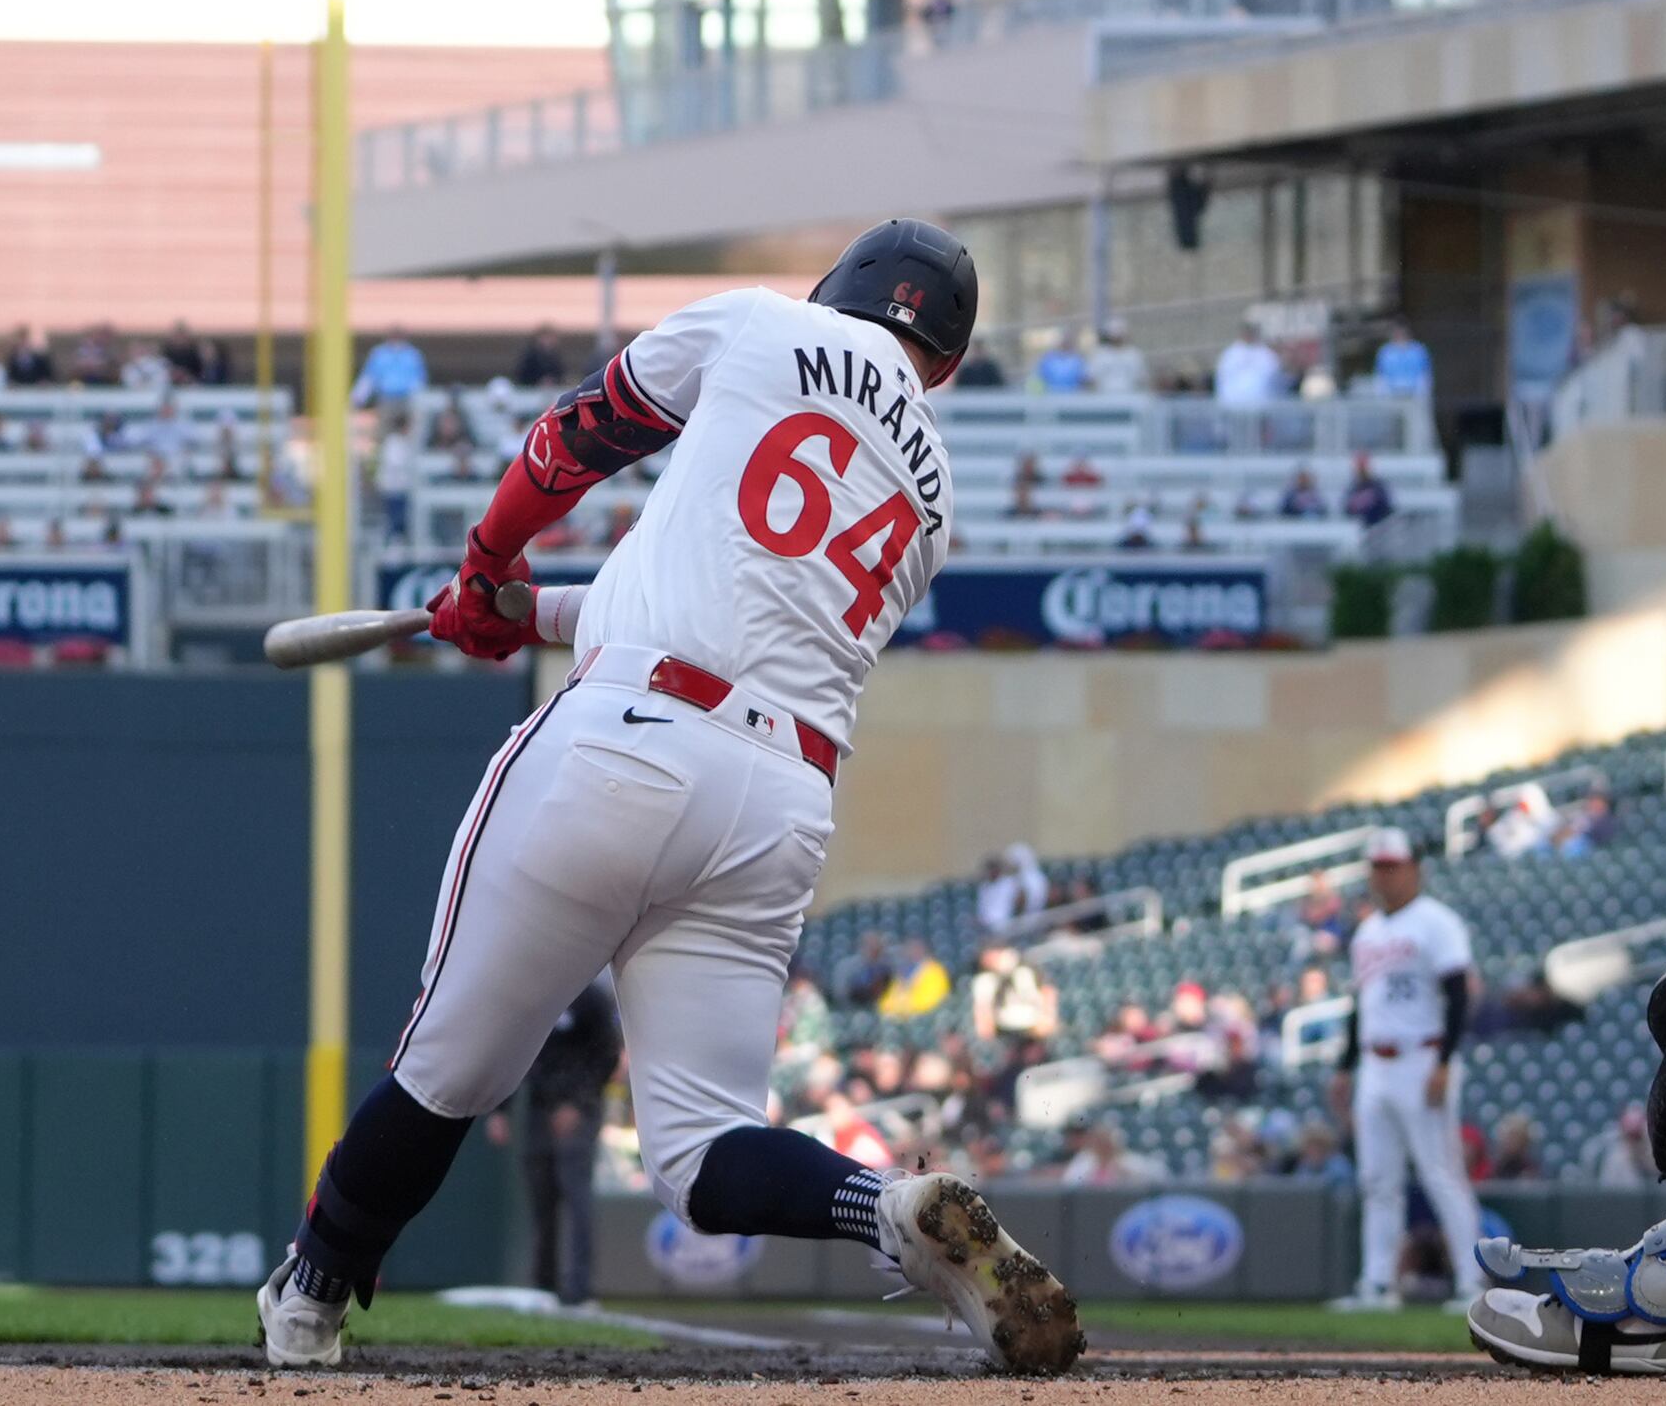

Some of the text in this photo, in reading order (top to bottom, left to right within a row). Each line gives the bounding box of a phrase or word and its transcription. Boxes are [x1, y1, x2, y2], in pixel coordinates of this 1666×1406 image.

[893, 281, 926, 310] 64
[794, 347, 944, 537] MIRANDA
[737, 411, 922, 641] 64
[1042, 566, 1261, 644] Corona
[149, 1231, 265, 1285] 328
